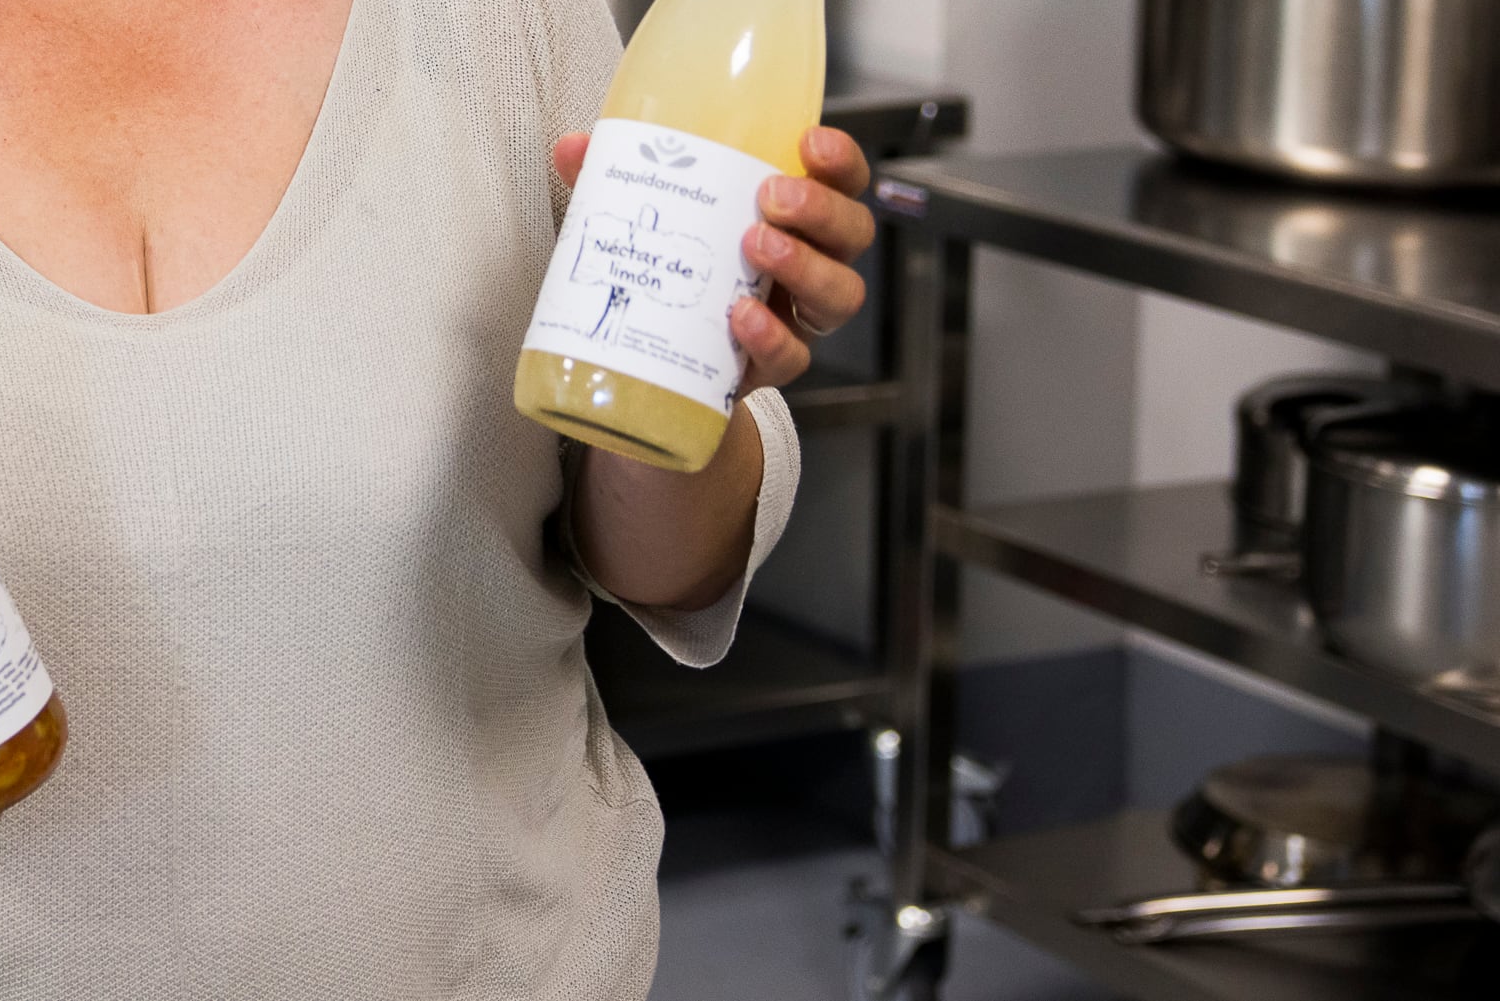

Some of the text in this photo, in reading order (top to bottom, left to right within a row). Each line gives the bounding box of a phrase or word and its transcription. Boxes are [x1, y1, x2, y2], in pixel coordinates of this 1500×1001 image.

[604, 164, 718, 206] daquidarredor
[595, 238, 693, 278] Néctar de
[610, 260, 661, 290] limón
